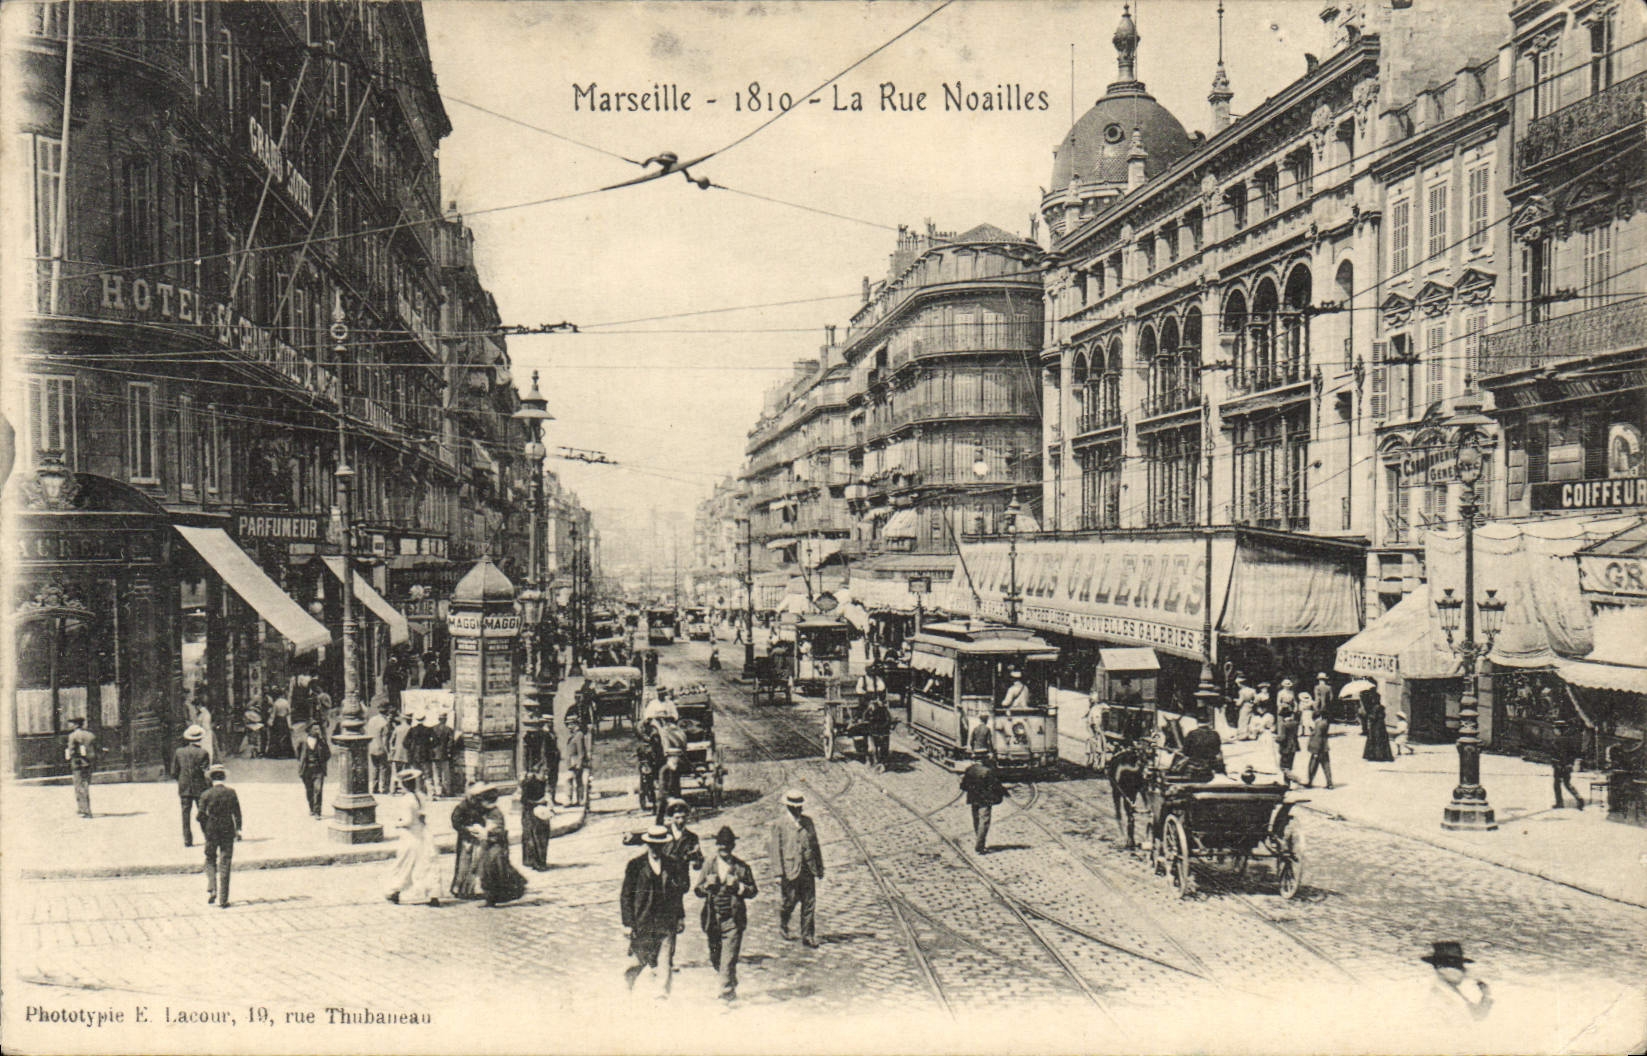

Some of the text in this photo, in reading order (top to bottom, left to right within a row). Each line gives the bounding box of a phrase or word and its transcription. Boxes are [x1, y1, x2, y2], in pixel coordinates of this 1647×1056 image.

[99, 273, 202, 327] HOTEL
[1561, 479, 1647, 508] COIFFEUR
[239, 516, 318, 538] PARFUMEUR
[484, 617, 520, 630] MAGGI
[1080, 615, 1135, 638] NOUVELLES
[1139, 622, 1195, 650] GALERIES
